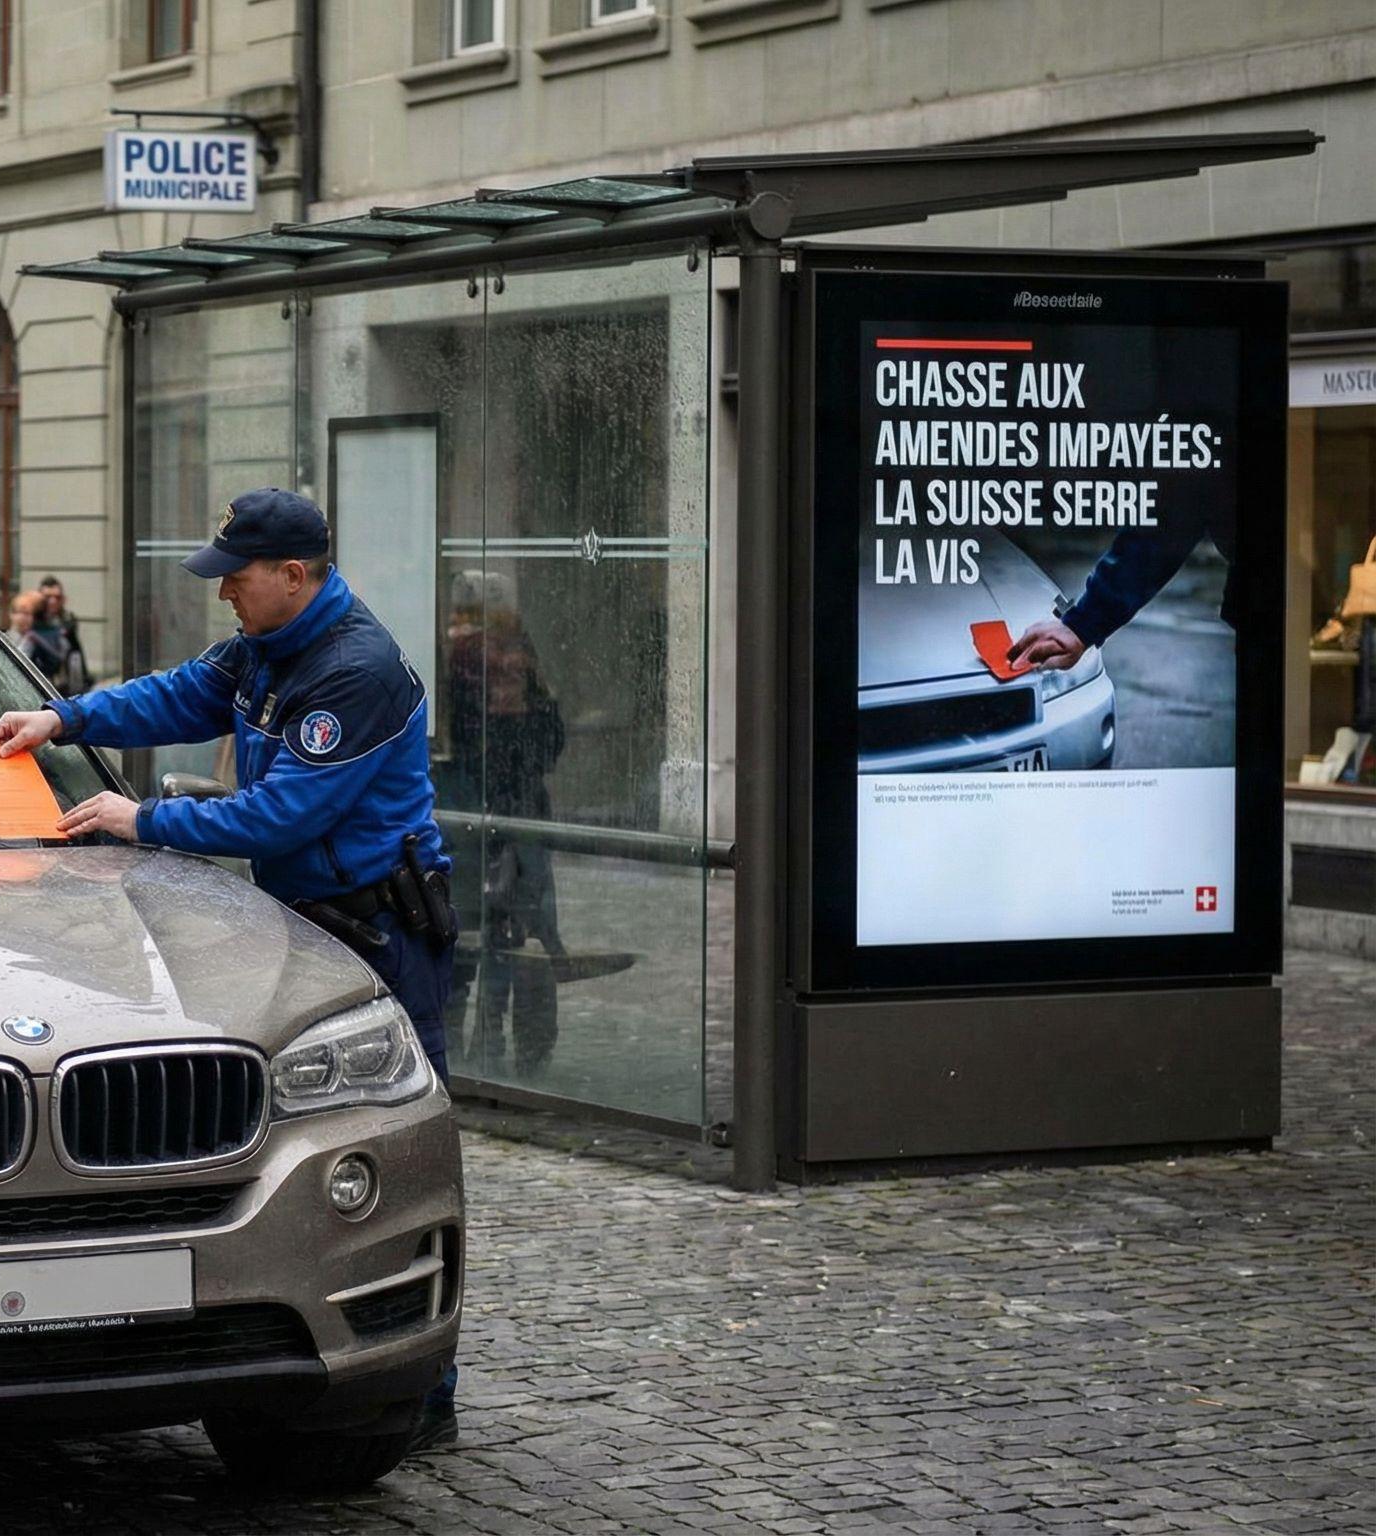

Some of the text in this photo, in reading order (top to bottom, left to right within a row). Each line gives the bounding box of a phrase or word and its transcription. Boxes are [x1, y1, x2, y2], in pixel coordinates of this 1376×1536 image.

[124, 139, 247, 176] POLICE
[124, 179, 247, 202] MUNICIPALE
[876, 360, 1085, 409] CHASSE AUX
[875, 413, 1222, 469] AMENDES IMPAYÉES:
[875, 479, 1159, 527] LA SUISSE SERRE
[875, 539, 980, 585] LA VIS
